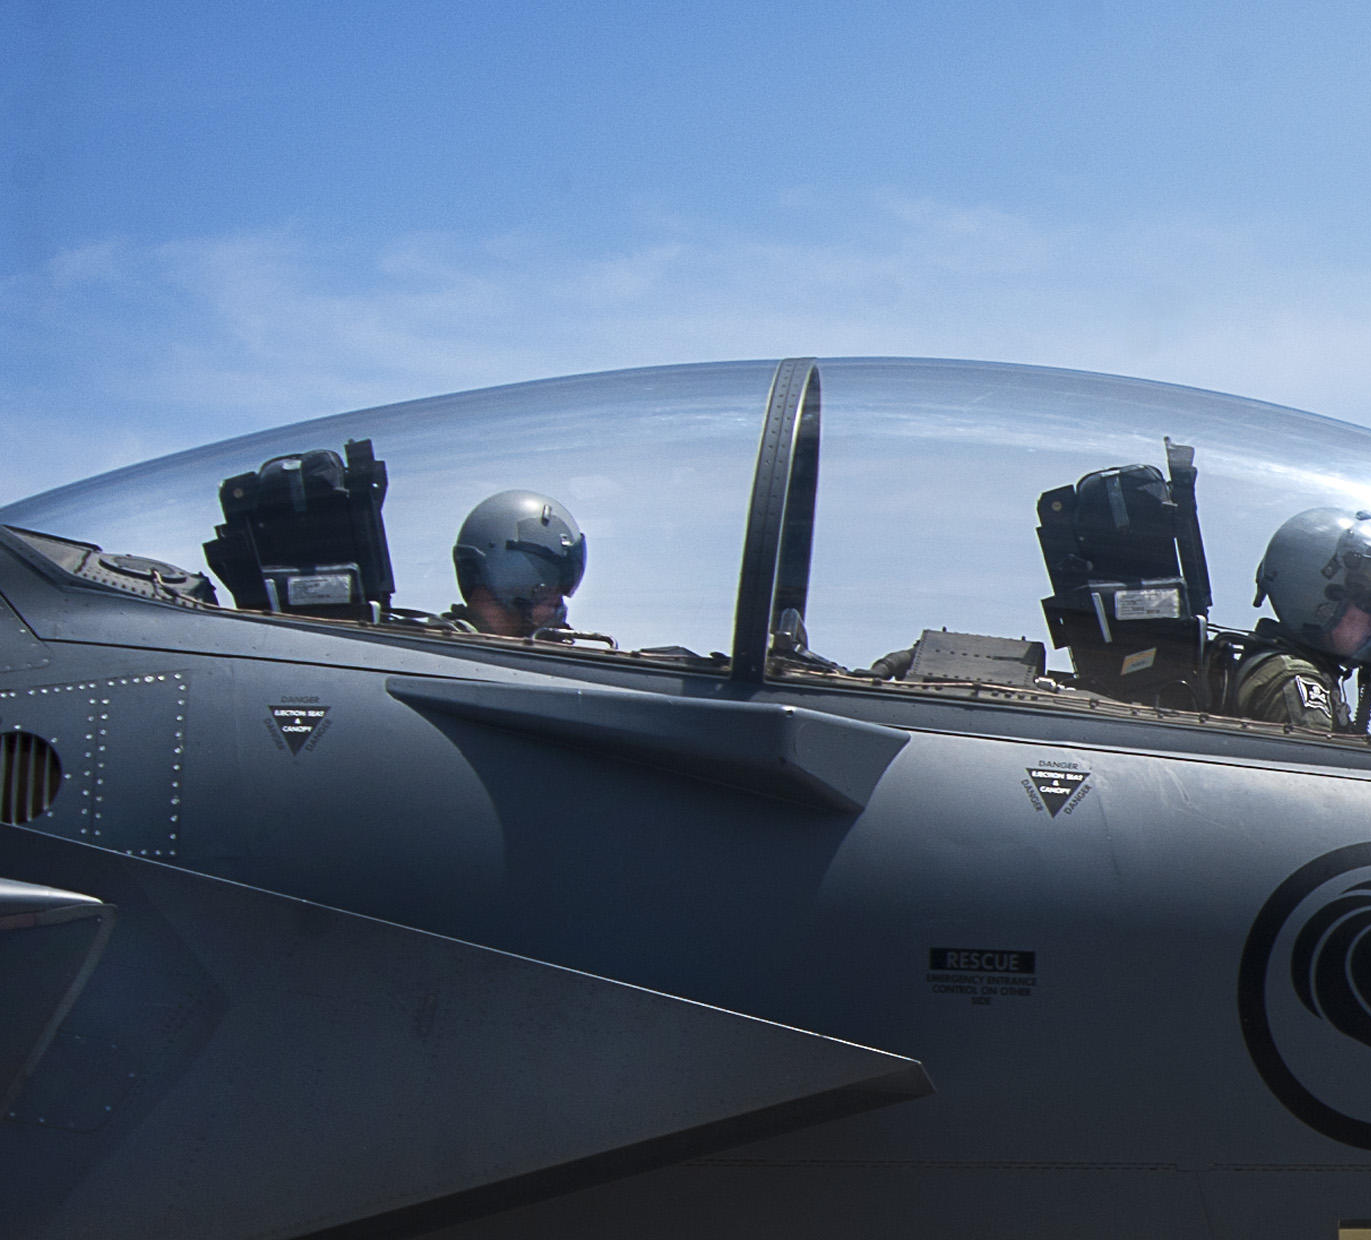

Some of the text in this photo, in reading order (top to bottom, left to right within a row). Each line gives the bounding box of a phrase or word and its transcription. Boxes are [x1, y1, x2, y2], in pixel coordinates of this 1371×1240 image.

[1038, 760, 1079, 770] DANGER
[1063, 783, 1092, 815] DANGER
[946, 951, 1020, 971] RESCUE
